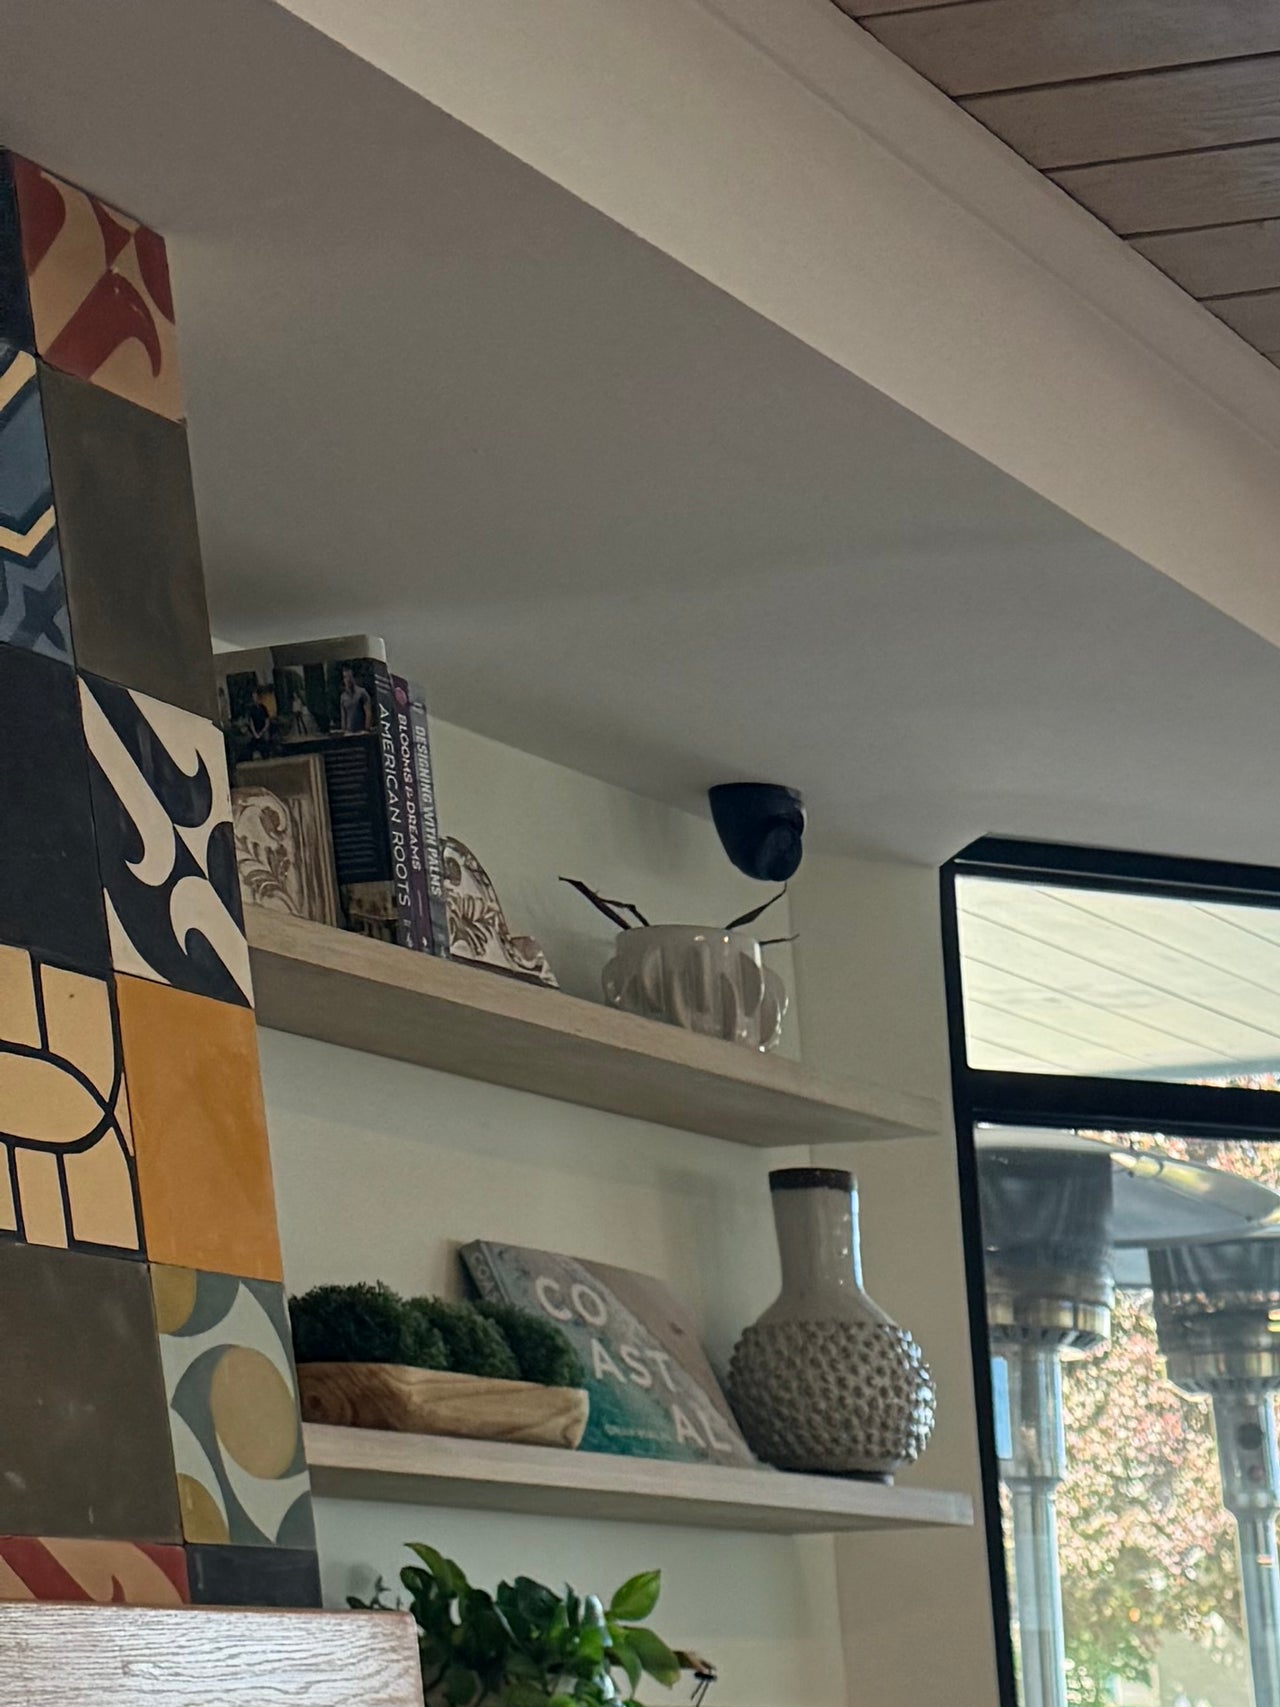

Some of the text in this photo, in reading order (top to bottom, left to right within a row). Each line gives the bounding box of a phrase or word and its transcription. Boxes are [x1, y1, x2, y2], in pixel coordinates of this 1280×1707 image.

[379, 702, 412, 908] AMERICAN ROOTS
[397, 713, 414, 784] BLOOMS
[406, 800, 422, 872] DREAMS
[414, 725, 443, 898] DESIGNING WITH PALMS
[534, 1274, 609, 1328] CO
[590, 1337, 677, 1393] AST
[670, 1403, 732, 1452] AL
